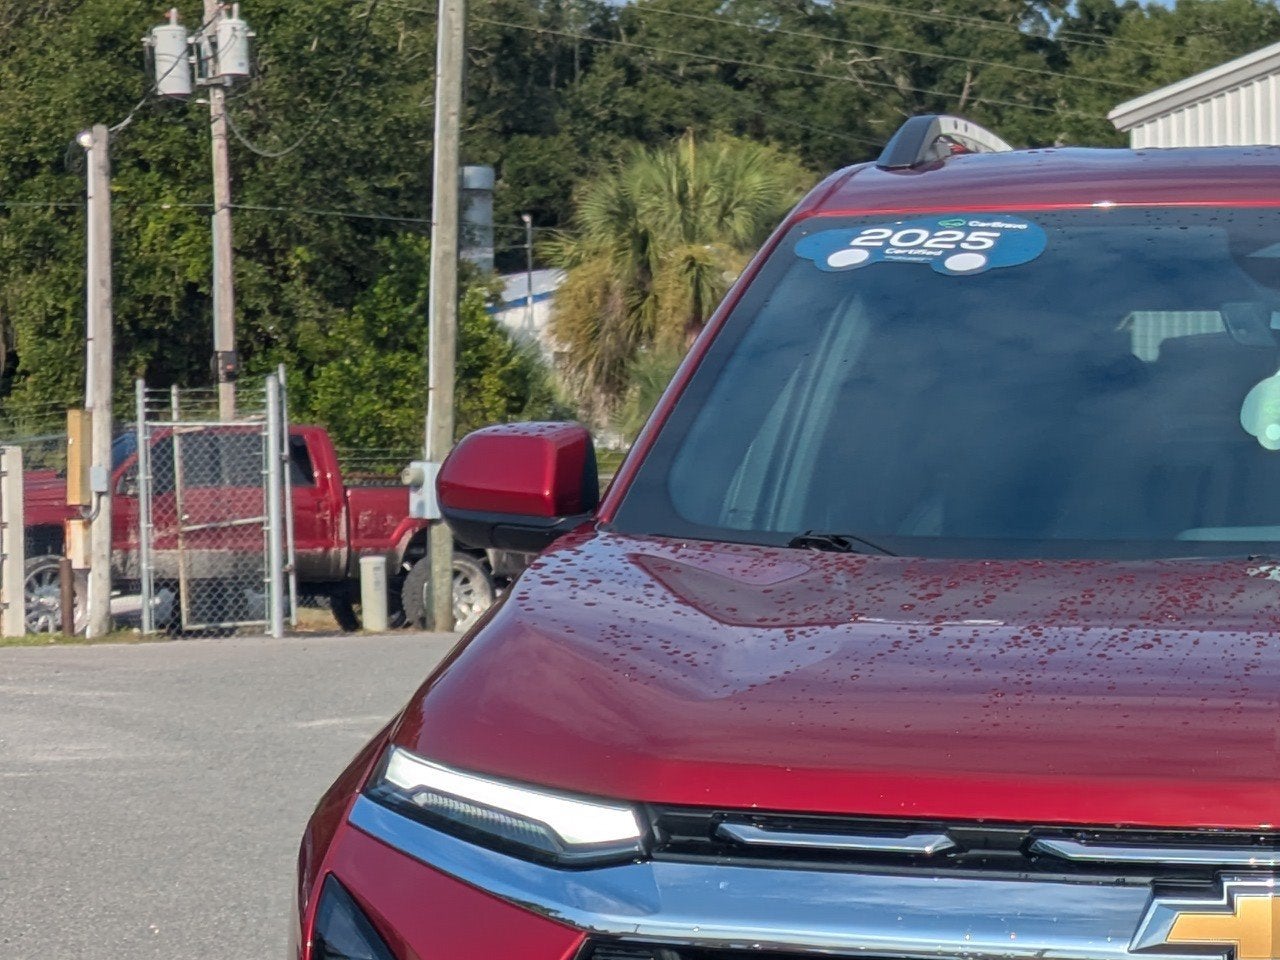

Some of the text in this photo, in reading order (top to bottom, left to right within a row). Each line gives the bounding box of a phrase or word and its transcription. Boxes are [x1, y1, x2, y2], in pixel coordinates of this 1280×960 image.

[968, 220, 1028, 230] CarBravo
[850, 228, 1001, 250] 2025
[884, 247, 944, 256] Certified
